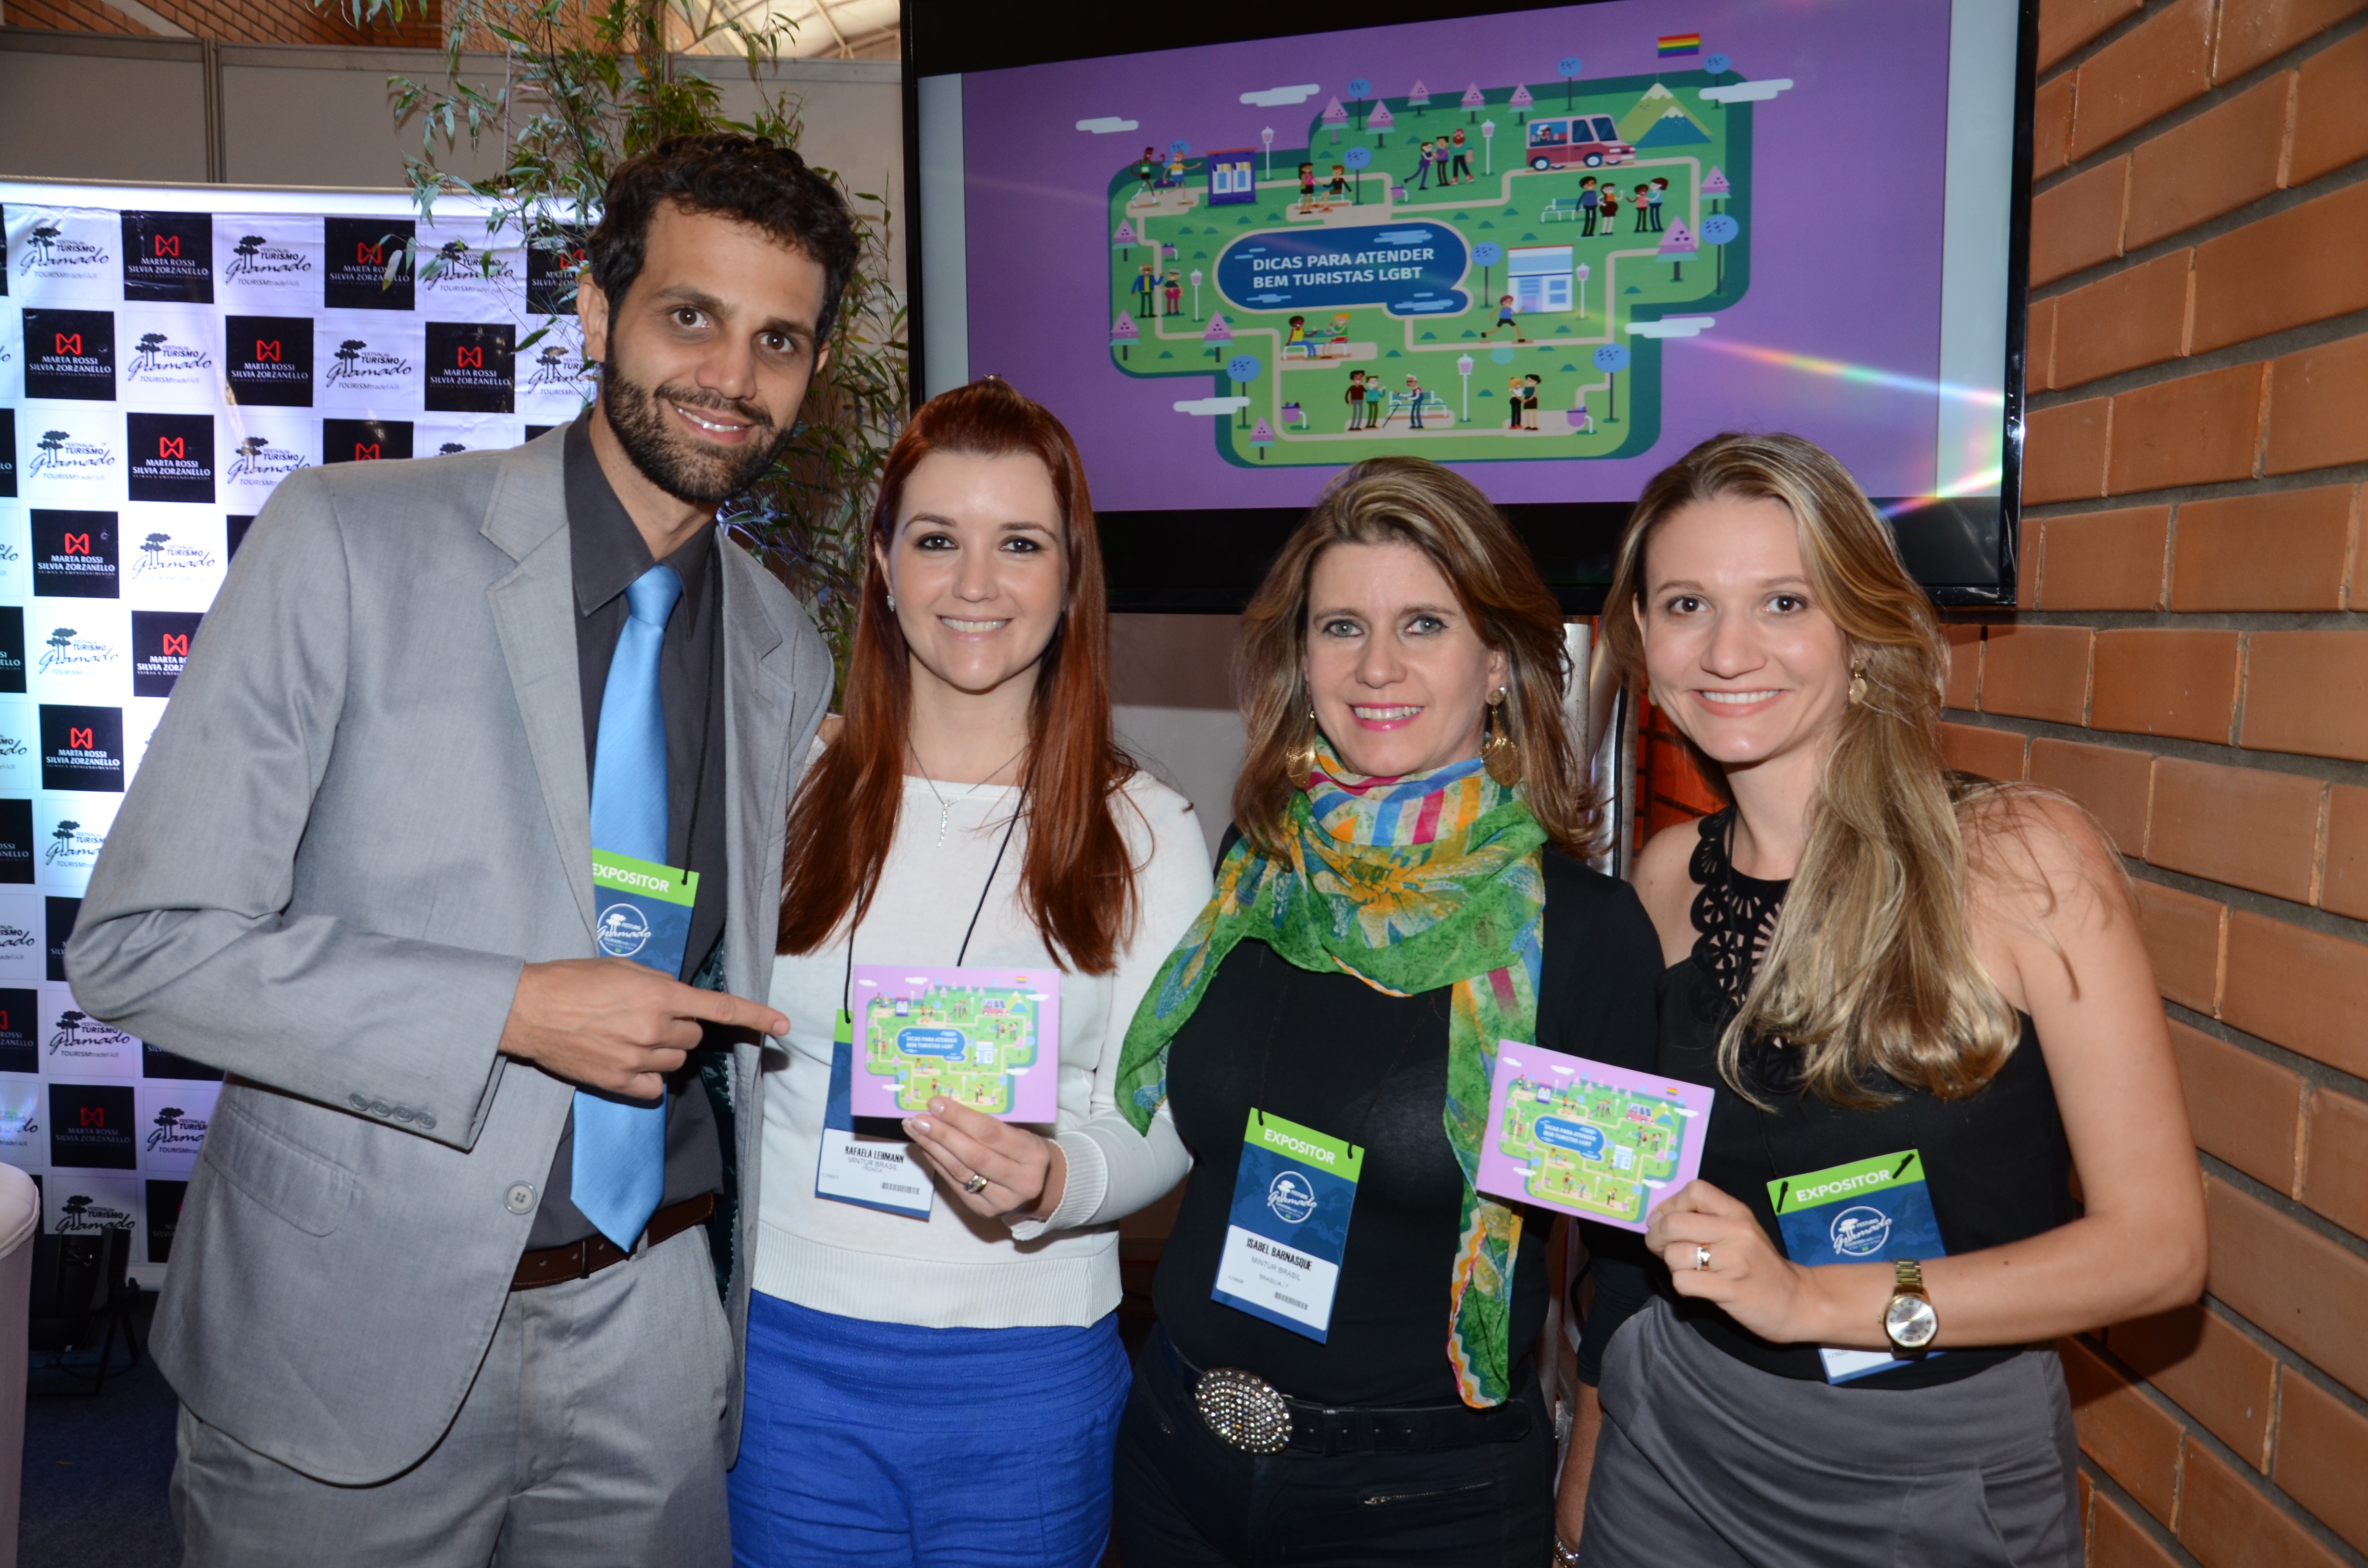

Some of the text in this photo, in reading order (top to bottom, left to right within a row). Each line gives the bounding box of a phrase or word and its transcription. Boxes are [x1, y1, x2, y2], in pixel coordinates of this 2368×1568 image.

[56, 245, 95, 253] TURISMO
[1253, 248, 1434, 271] DICAS PARA ATENDER
[155, 266, 209, 275] ZORZANELLO
[225, 254, 311, 284] Gramado
[1253, 267, 1423, 288] BEM TURISTAS LGBT
[56, 364, 111, 373] ZORZANELLO
[128, 352, 211, 381] Gramado
[257, 371, 308, 380] ZORZANELLO
[326, 358, 411, 388] Gramado
[456, 377, 509, 385] ZORZANELLO
[30, 449, 117, 478] Gramado
[160, 467, 210, 476] ZORZANELLO
[65, 563, 116, 572] ZORZANELLO
[137, 663, 162, 671] SILVIA
[70, 758, 120, 766] ZORZANELLO
[592, 863, 669, 893] EXPOSITOR
[49, 1031, 130, 1055] Gramado
[845, 1146, 904, 1163] RAFAELA LEHMANN
[1264, 1128, 1335, 1164] EXPOSITOR
[848, 1157, 898, 1170] MINTUR BRASIL
[1796, 1169, 1891, 1202] EXPOSITOR
[1267, 1191, 1317, 1209] Gramado
[1833, 1215, 1892, 1255] Gramado
[1246, 1237, 1313, 1271] ISABEL BARNASQUE
[1251, 1257, 1301, 1281] MINTUR BRASIL
